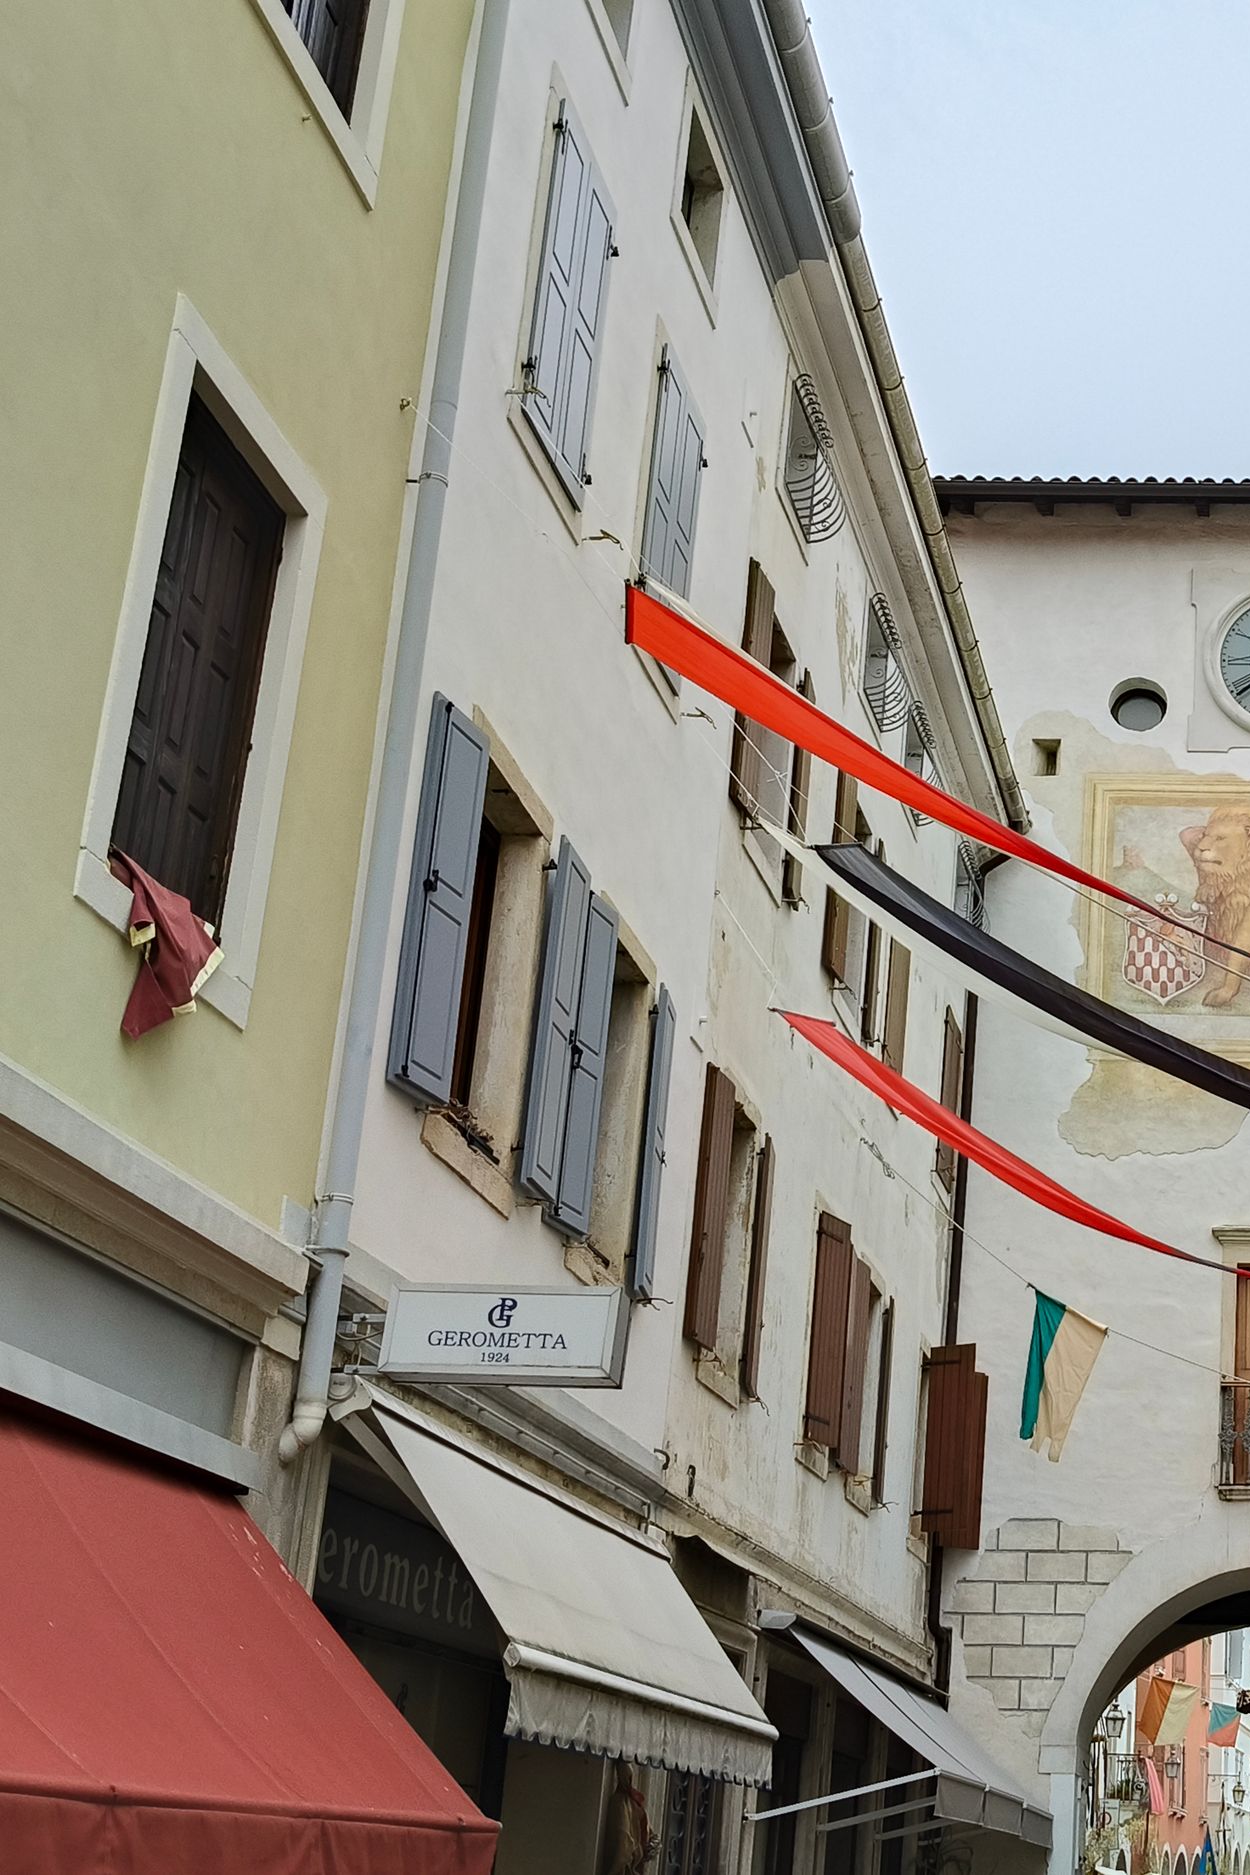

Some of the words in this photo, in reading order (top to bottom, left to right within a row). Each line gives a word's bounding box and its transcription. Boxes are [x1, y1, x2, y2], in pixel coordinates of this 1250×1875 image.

[428, 1330, 567, 1350] GEROMETTA
[480, 1352, 510, 1363] 1924
[317, 1527, 475, 1631] erometta
